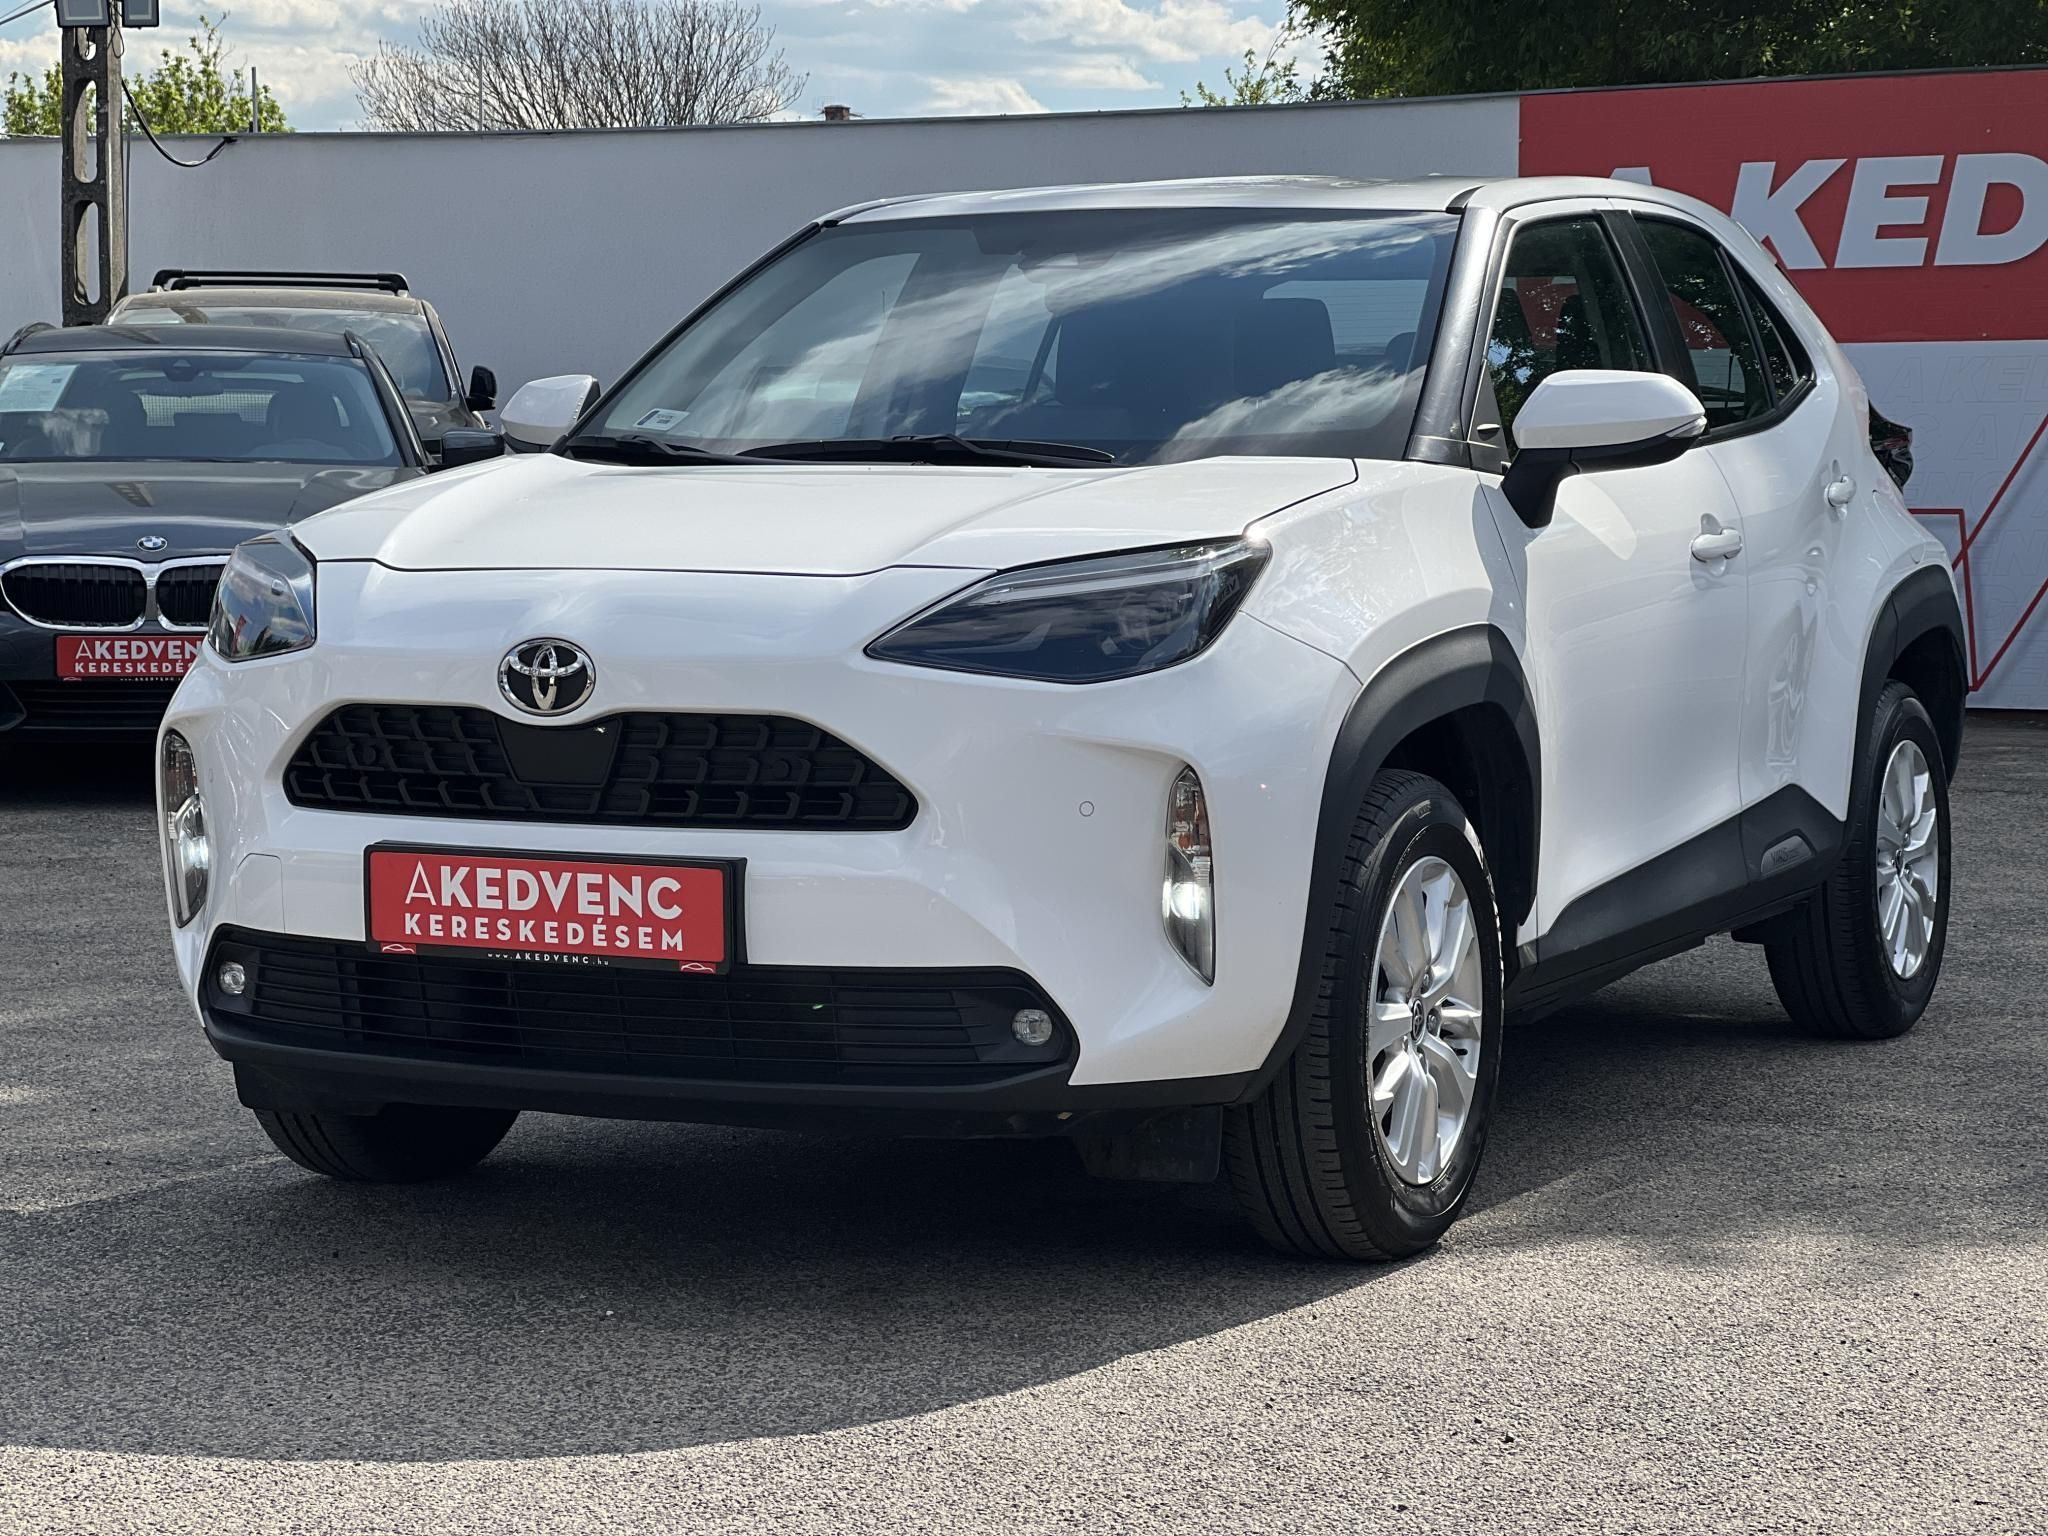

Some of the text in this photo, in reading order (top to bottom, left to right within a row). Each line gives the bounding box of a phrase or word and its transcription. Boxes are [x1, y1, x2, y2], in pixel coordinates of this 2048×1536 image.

[404, 859, 684, 920] AKEDVENC
[404, 912, 684, 952] KERESKEDÉSEM
[487, 952, 610, 966] www.AKEDVENC.hu
